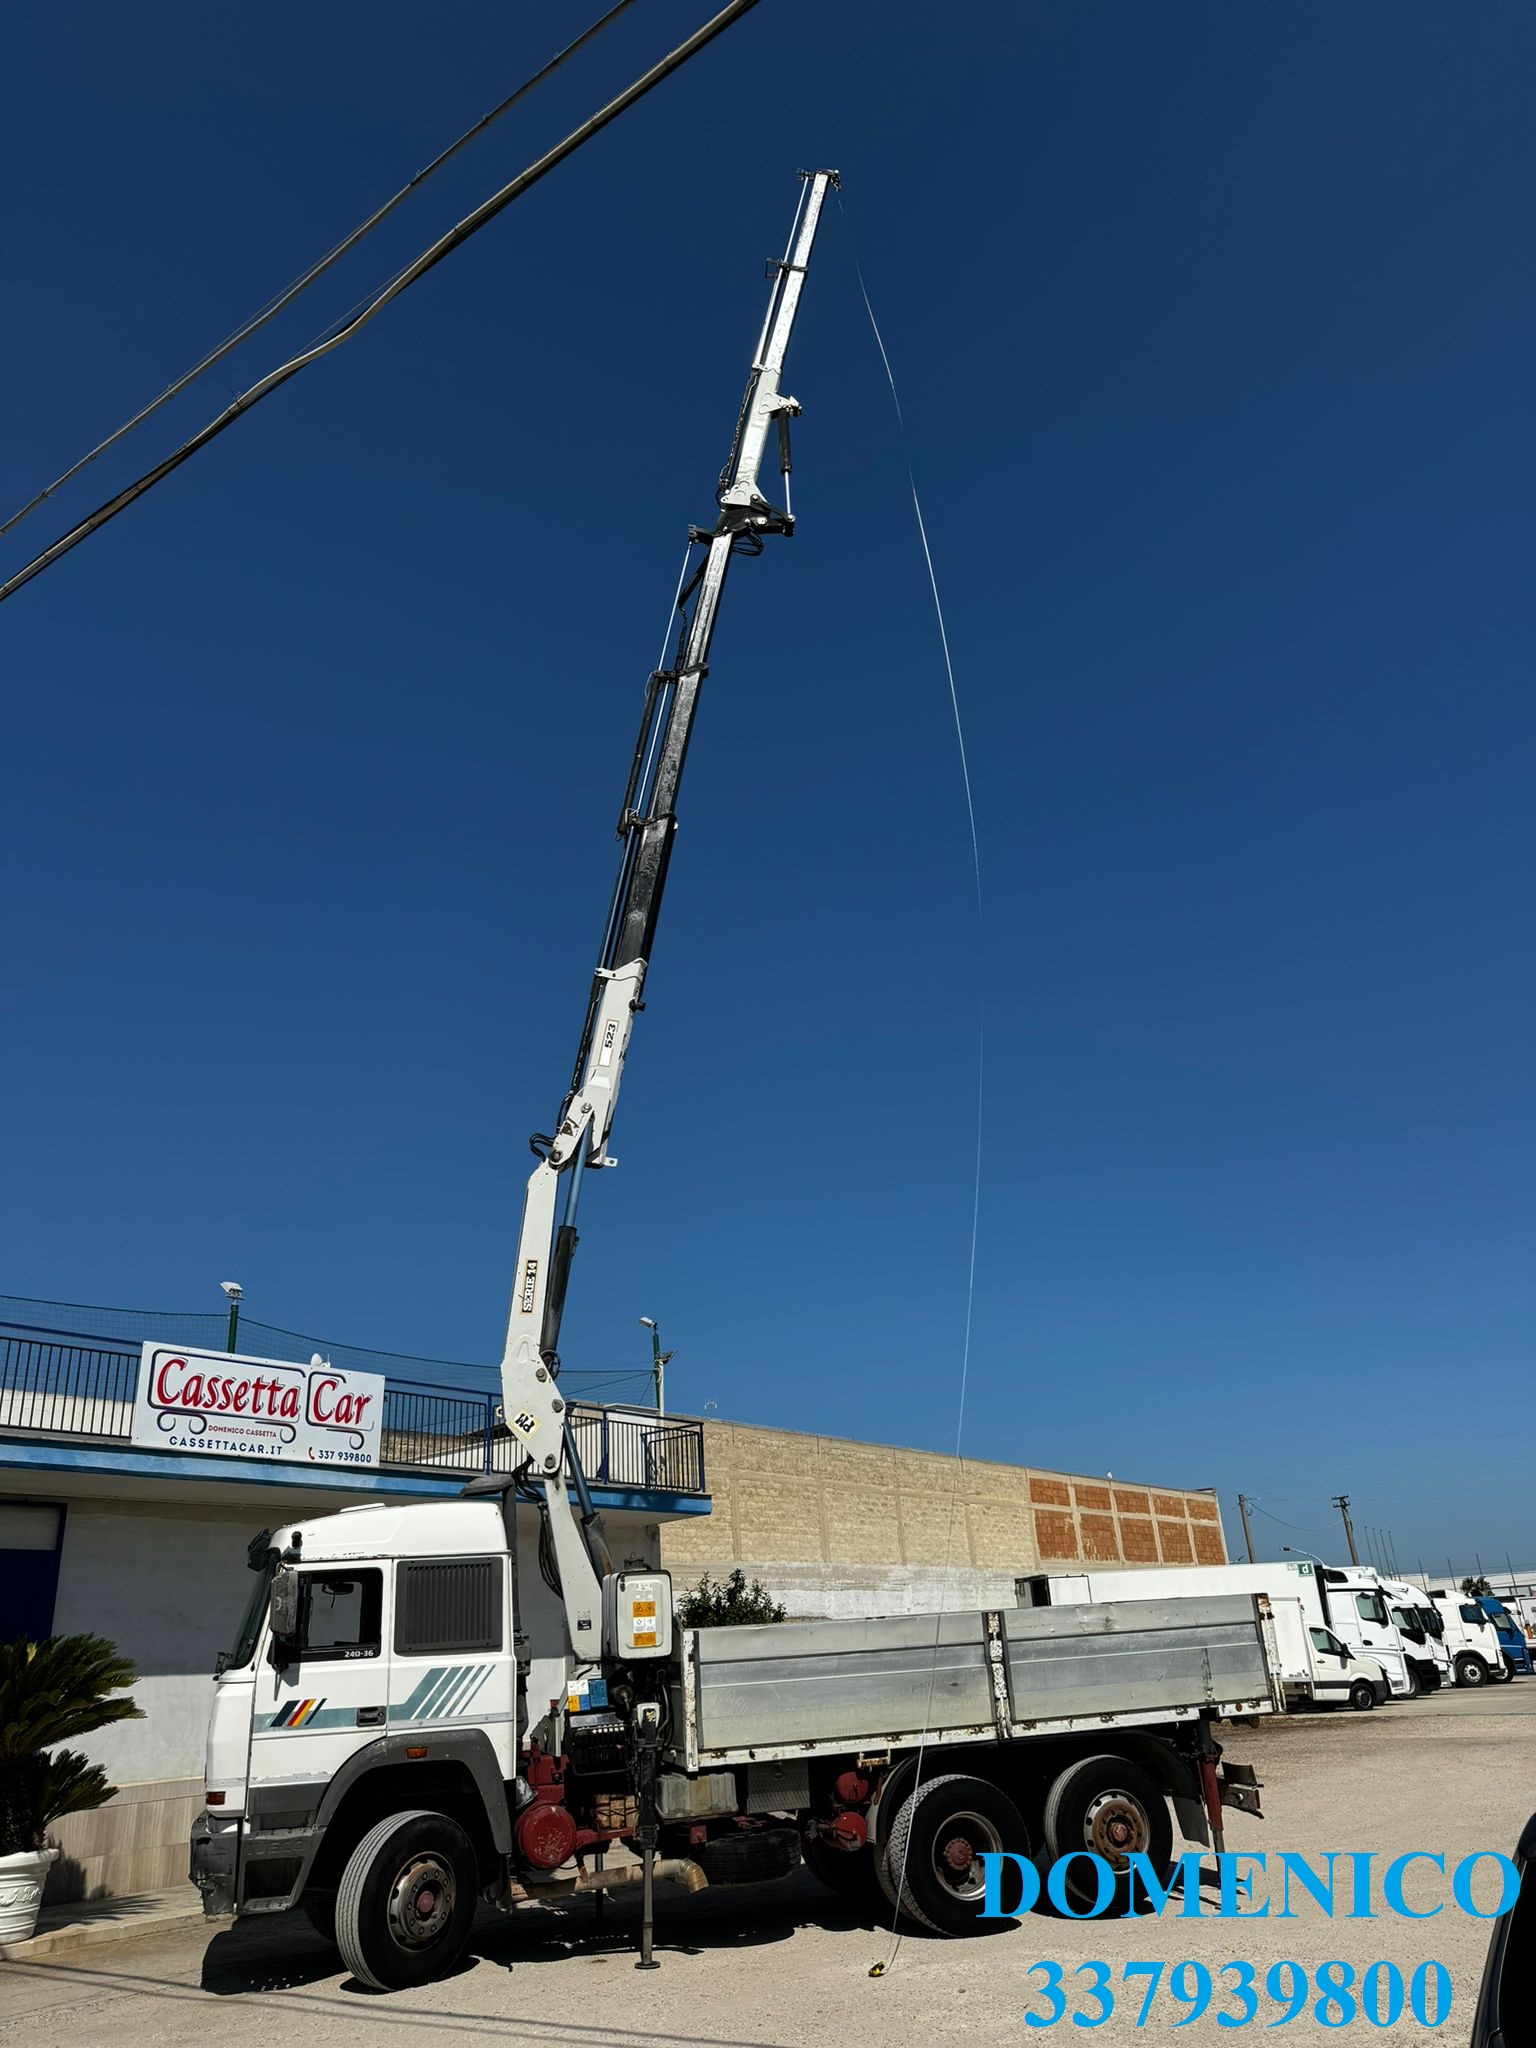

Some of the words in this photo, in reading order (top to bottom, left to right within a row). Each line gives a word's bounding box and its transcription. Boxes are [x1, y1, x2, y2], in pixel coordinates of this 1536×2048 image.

[604, 1023, 616, 1049] 523
[526, 1262, 536, 1275] 14
[522, 1276, 534, 1311] SERIE
[156, 1357, 301, 1418] Cassetta
[313, 1378, 374, 1425] Car
[208, 1425, 244, 1435] DOMENICO
[245, 1429, 277, 1438] CASSETTA
[169, 1436, 282, 1455] CASSETTACAR.IT
[318, 1449, 335, 1460] 337
[337, 1451, 372, 1463] 939800
[344, 1649, 374, 1658] 240-36
